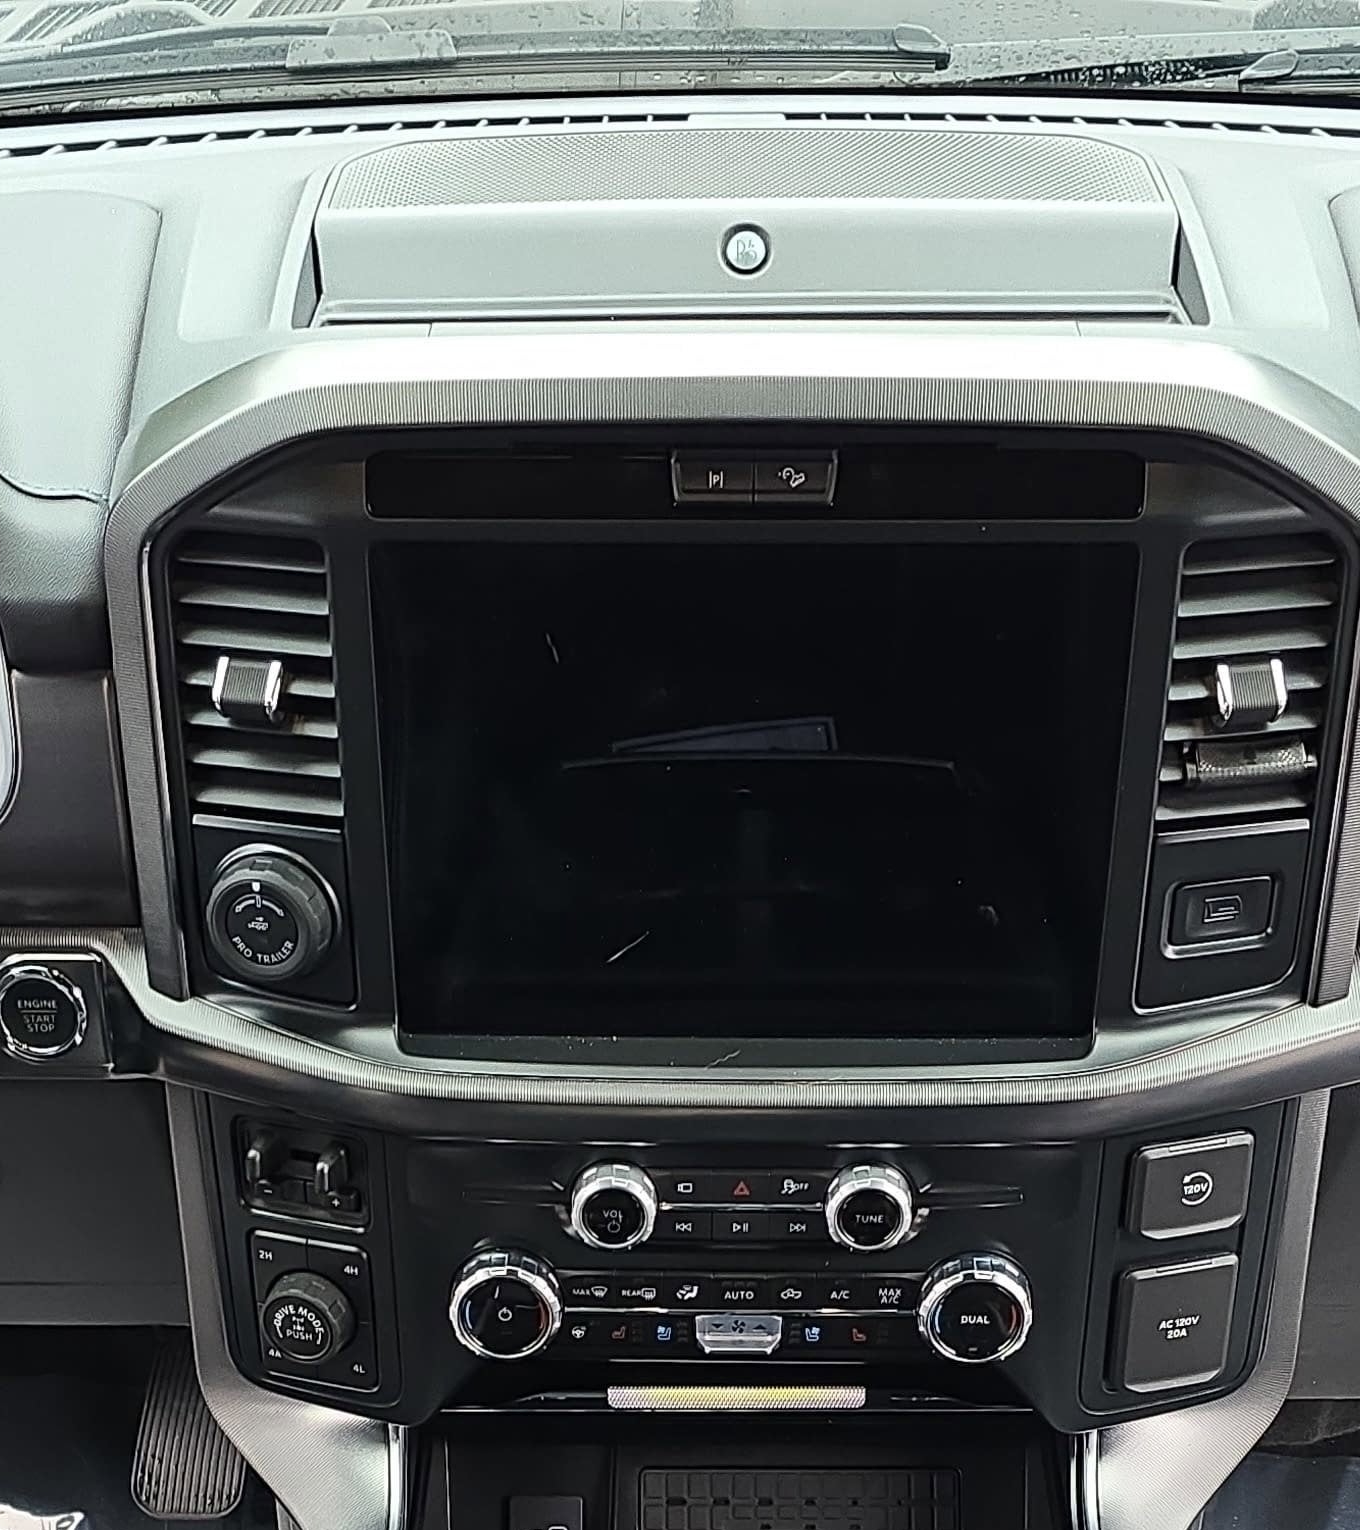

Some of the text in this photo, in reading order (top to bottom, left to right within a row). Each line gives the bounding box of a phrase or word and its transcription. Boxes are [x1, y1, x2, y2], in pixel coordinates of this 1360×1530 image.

[232, 936, 294, 964] PRO TRAILER
[17, 1000, 58, 1009] ENGINE
[23, 1015, 55, 1023] START
[27, 1024, 55, 1032] STOP
[1183, 1181, 1209, 1195] 120V
[602, 1210, 622, 1219] VOL
[855, 1215, 884, 1224] TUNE
[258, 1250, 273, 1261] 2H
[343, 1265, 359, 1276] 4H
[572, 1288, 590, 1297] MAX
[621, 1288, 641, 1297] REAR
[724, 1290, 754, 1300] AUTO
[830, 1289, 850, 1300] A/C
[878, 1288, 902, 1297] MAX
[881, 1295, 900, 1305] A/C
[273, 1304, 325, 1333] DRIVE MODE
[960, 1315, 990, 1325] DUAL
[1159, 1315, 1200, 1330] AC 120V
[286, 1329, 313, 1341] PUSH
[1166, 1328, 1188, 1339] 20A
[268, 1349, 282, 1359] 4A
[353, 1364, 367, 1374] 4L
